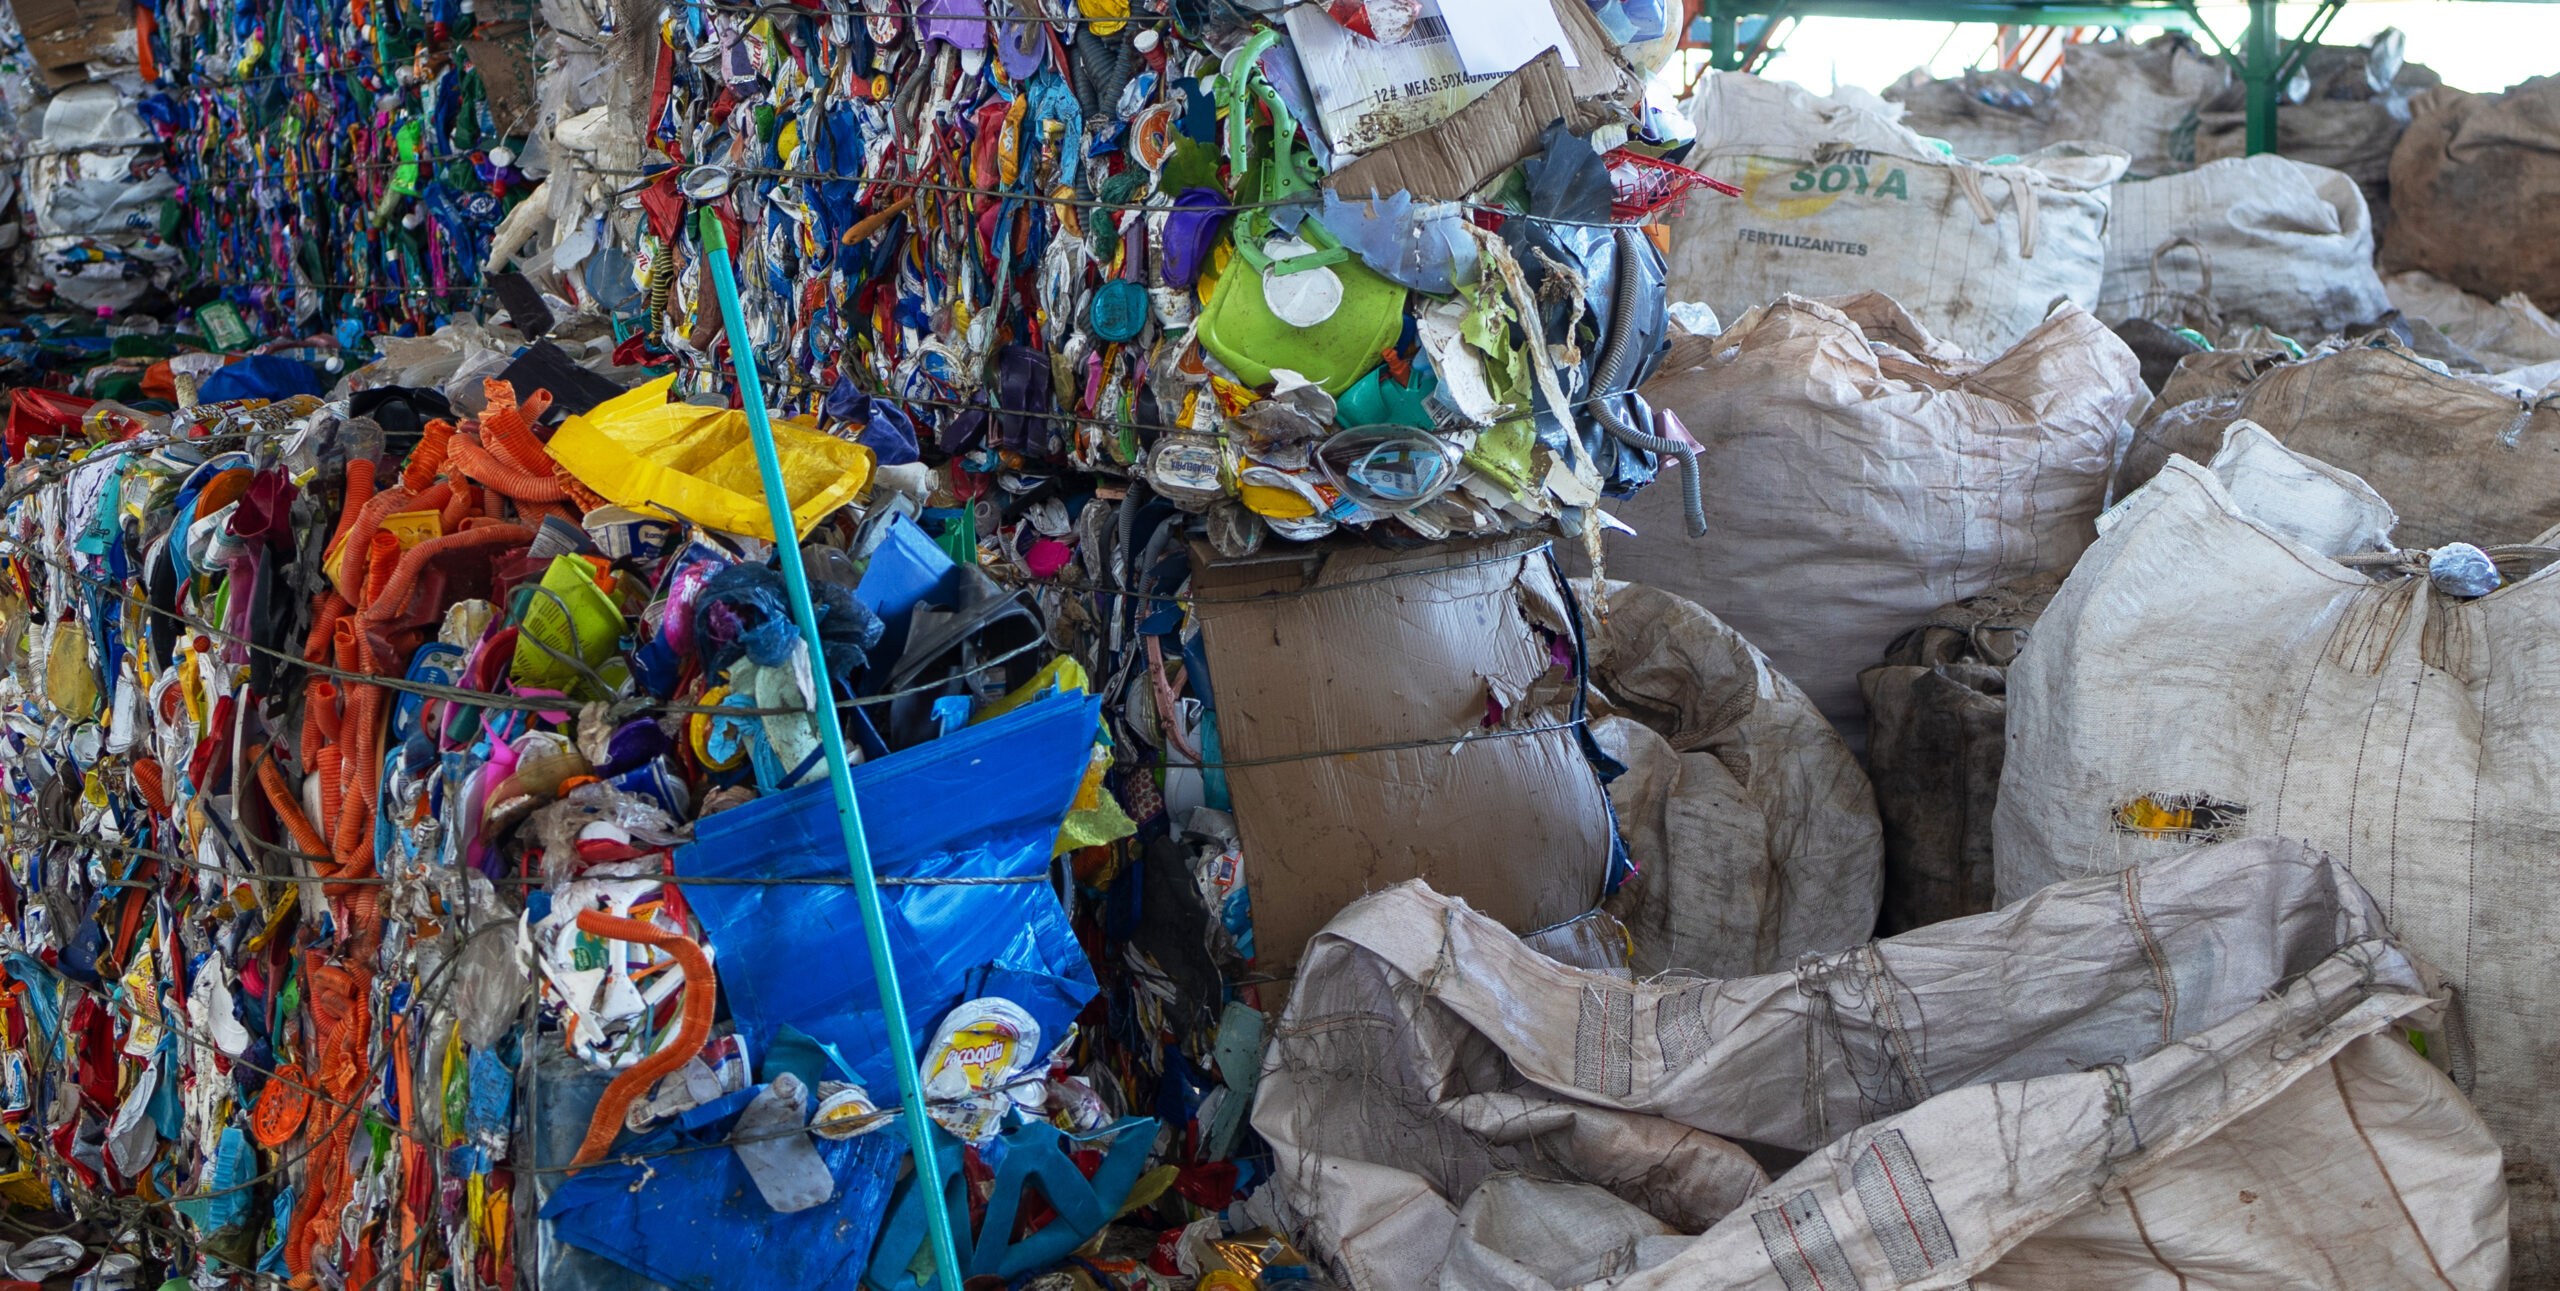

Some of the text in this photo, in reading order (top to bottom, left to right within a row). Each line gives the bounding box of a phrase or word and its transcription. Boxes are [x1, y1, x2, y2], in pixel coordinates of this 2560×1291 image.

[1374, 86, 1398, 103] 12#
[1817, 149, 1871, 165] UTRI
[1789, 164, 1908, 200] SOYA
[1738, 228, 1868, 256] FERTILIZANTES
